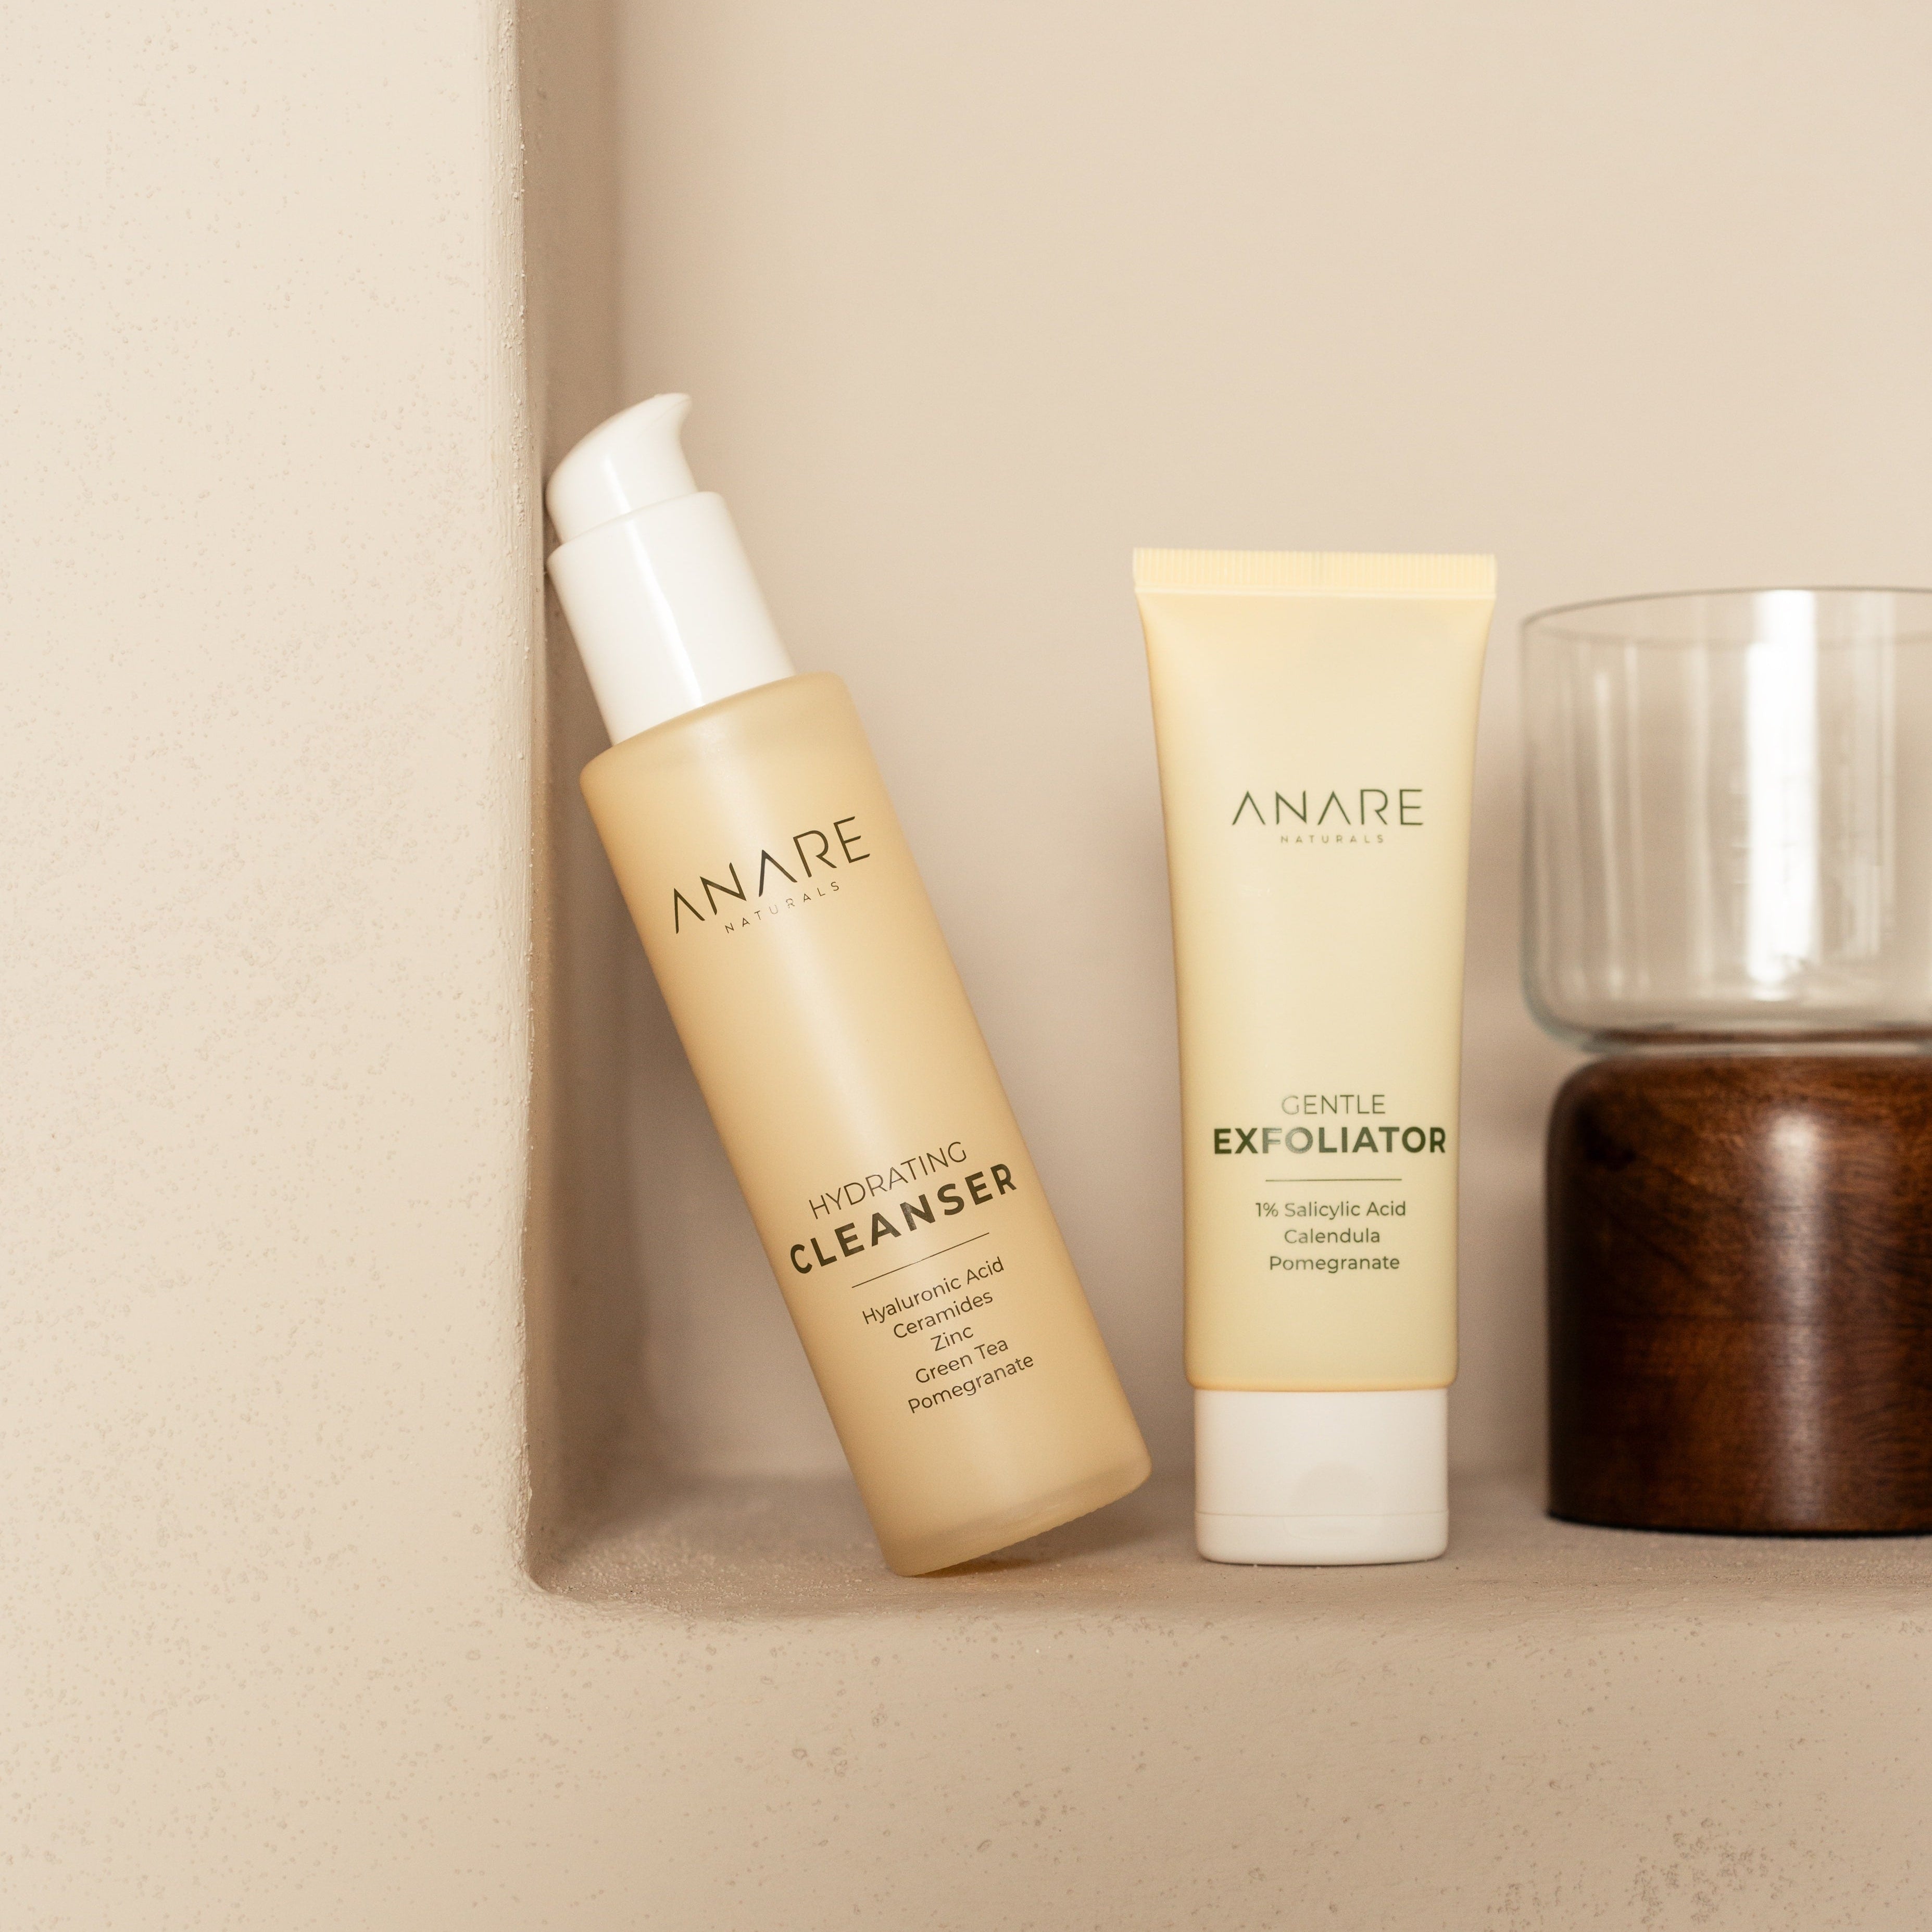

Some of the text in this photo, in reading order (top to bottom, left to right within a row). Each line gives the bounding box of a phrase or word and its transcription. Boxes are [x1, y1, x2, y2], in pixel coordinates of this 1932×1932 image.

[1232, 788, 1424, 825] ANARE
[1281, 834, 1384, 844] NATURALS
[673, 816, 870, 934] ANARE
[724, 881, 839, 934] NATURALS
[1281, 1094, 1386, 1115] GENTLE
[1213, 1126, 1446, 1155] EXFOLIATOR
[808, 1141, 967, 1220] HYDRATING
[789, 1163, 1017, 1274] CLEANSER
[1255, 1200, 1406, 1220] 1% Salicylic Acid
[1284, 1228, 1381, 1244] Calendula
[1270, 1255, 1400, 1274] Pomegranate
[862, 1256, 1005, 1325] Hyaluronic Acid
[893, 1289, 994, 1339] Ceramides
[930, 1324, 974, 1352] Zinc
[915, 1337, 1009, 1384] Green Tea
[907, 1354, 1034, 1414] Pomegranate
